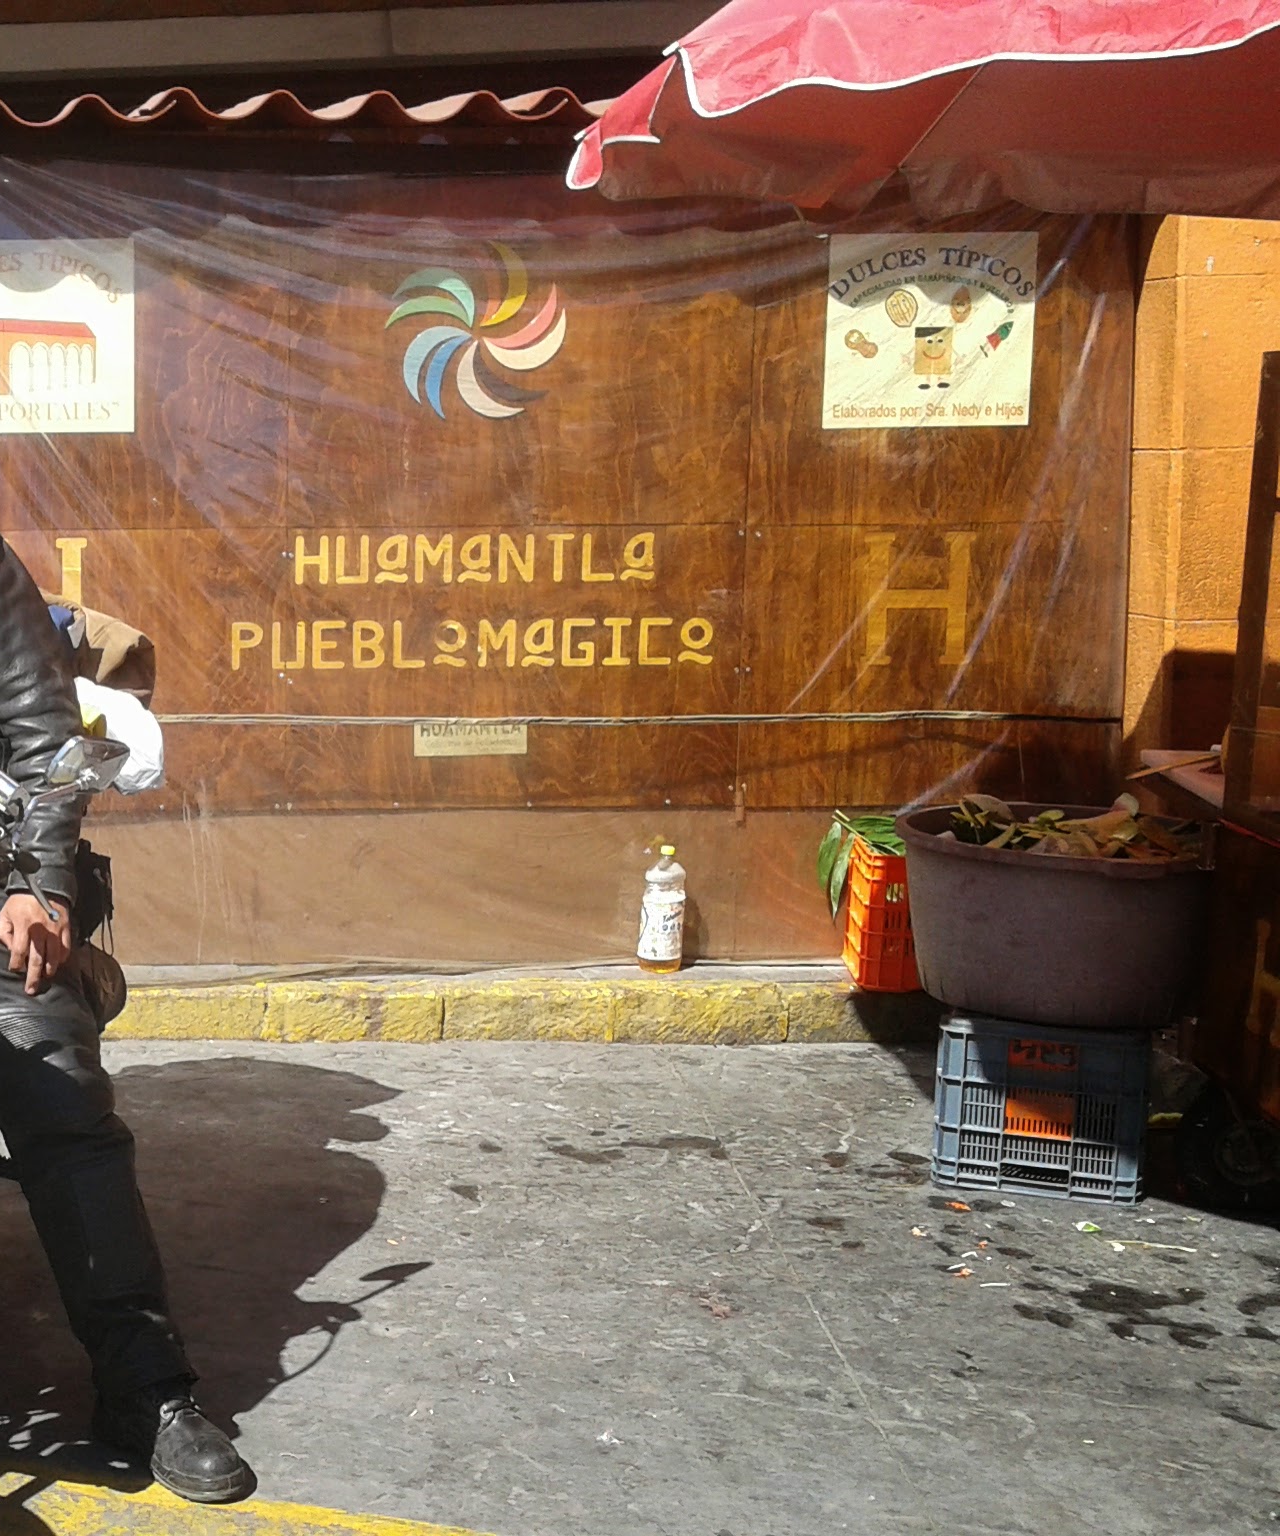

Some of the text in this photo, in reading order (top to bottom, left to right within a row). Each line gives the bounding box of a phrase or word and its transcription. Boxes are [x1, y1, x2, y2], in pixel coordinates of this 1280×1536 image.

[830, 248, 926, 299] DULCES
[832, 404, 897, 418] Elaborados
[952, 403, 982, 419] Nedy
[985, 406, 992, 416] e
[995, 402, 1024, 419] Hijos
[860, 531, 978, 666] H
